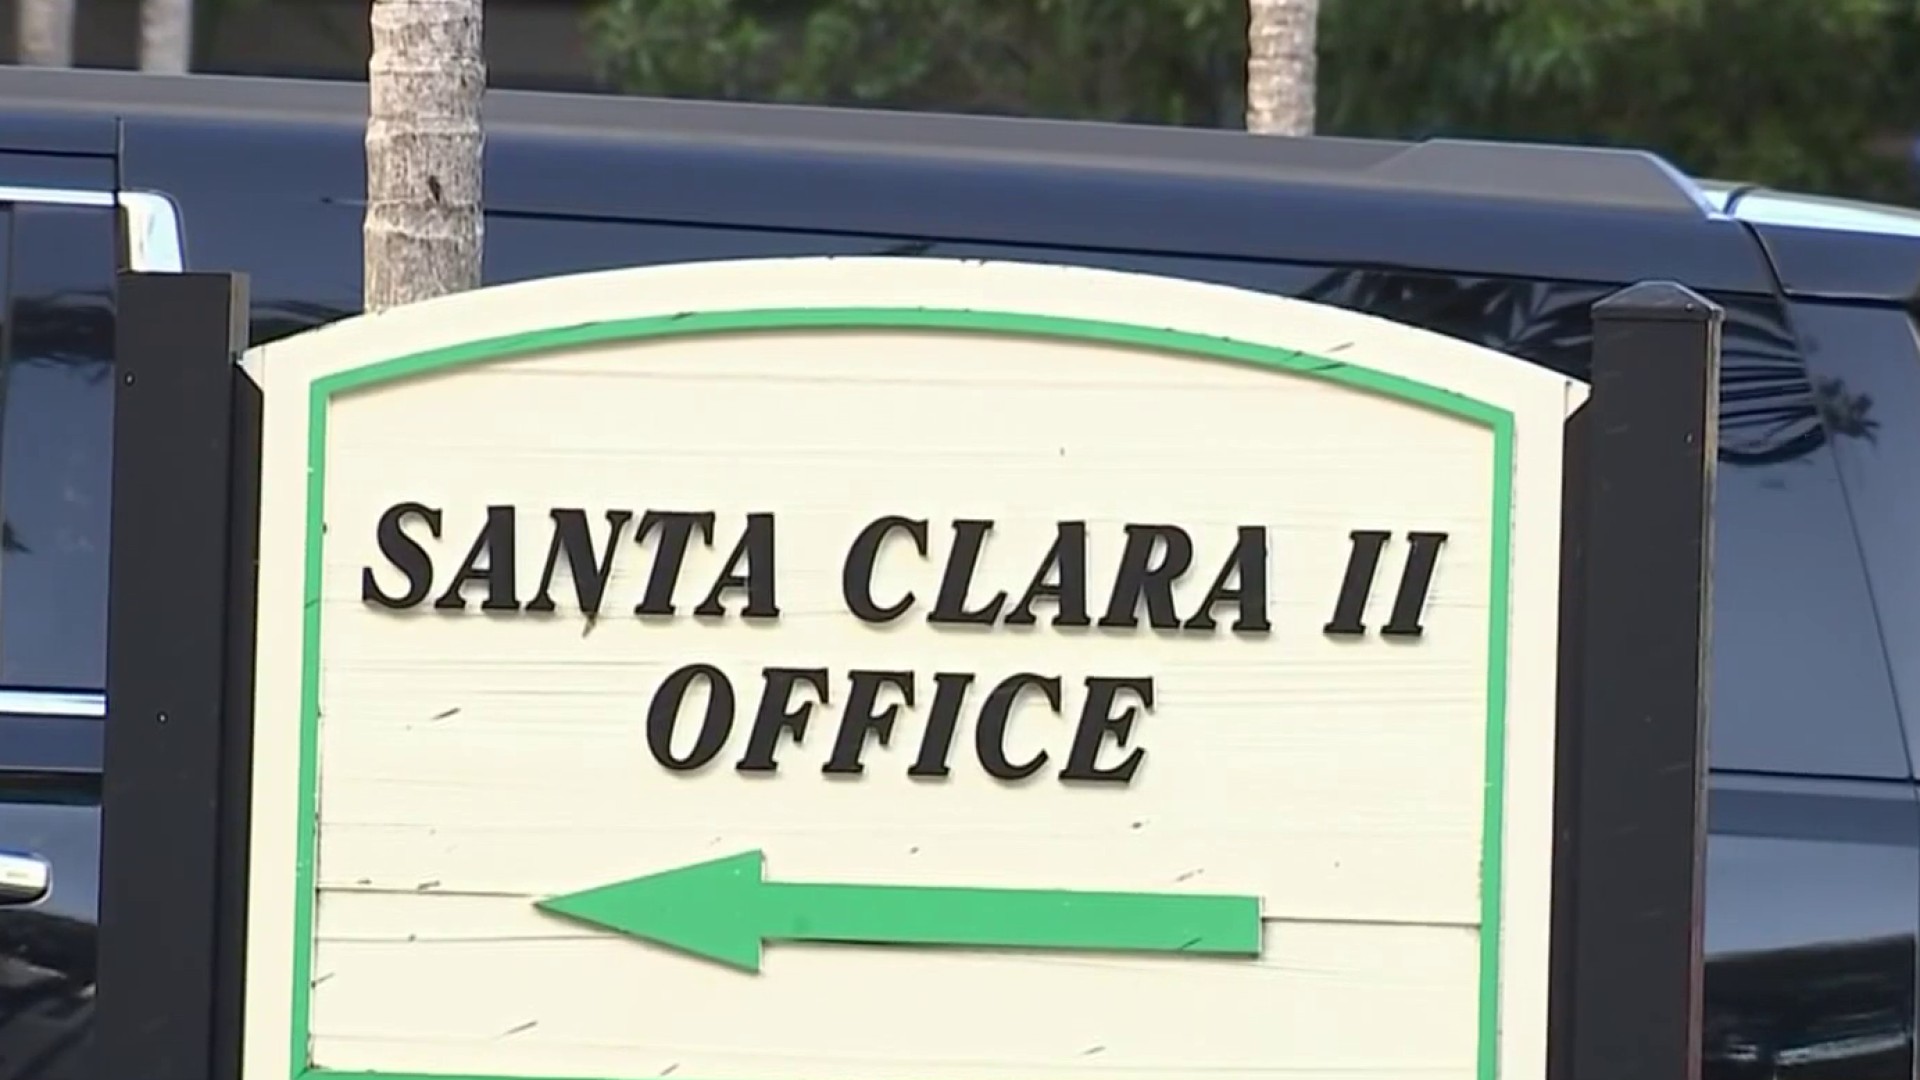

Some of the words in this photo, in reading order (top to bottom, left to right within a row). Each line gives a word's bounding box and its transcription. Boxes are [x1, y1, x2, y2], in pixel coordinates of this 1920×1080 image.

[361, 501, 780, 620] SANTA
[842, 515, 1272, 634] CLARA
[1323, 530, 1449, 638] II
[646, 663, 1154, 785] OFFICE
